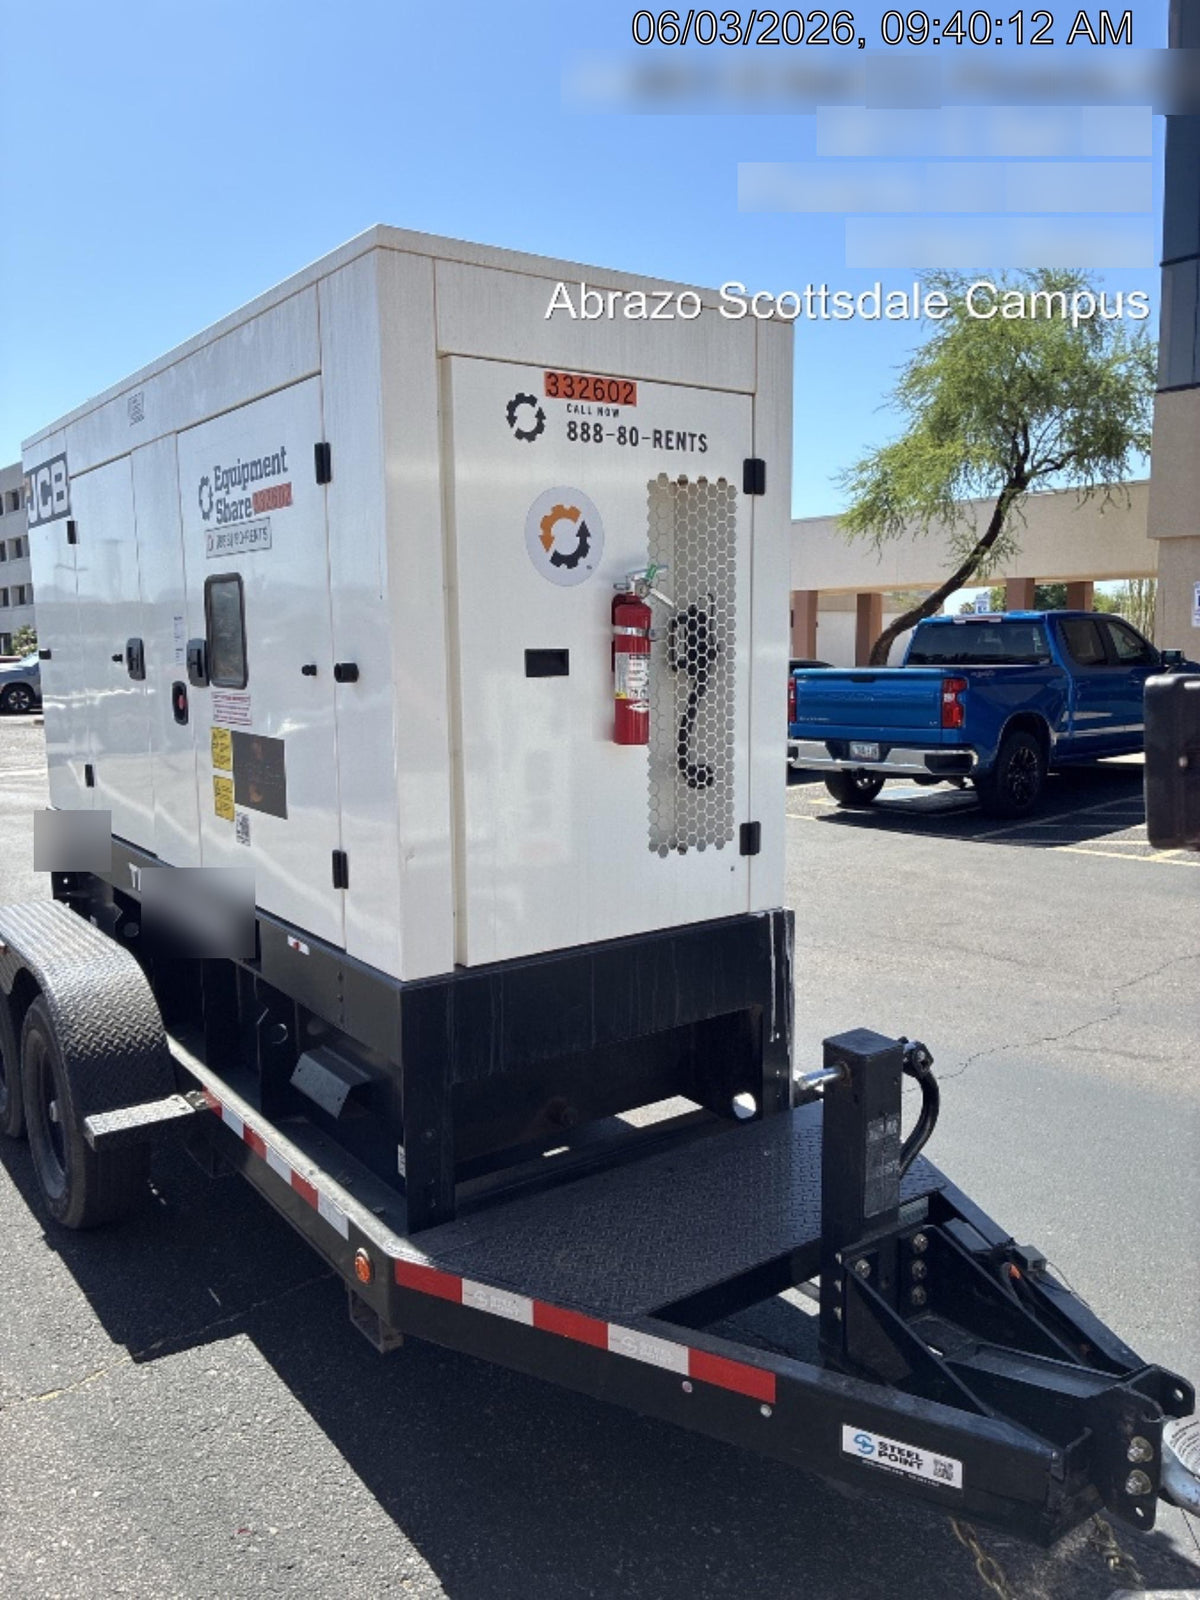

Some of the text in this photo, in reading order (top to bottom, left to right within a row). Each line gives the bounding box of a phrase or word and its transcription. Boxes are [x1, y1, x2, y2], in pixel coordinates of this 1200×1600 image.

[546, 373, 635, 405] 332602
[566, 403, 620, 418] CALL NOW
[567, 420, 708, 453] 888-80-RENTS
[214, 446, 289, 495] Equipment
[26, 456, 70, 526] JCB
[216, 497, 253, 525] Share
[878, 1441, 922, 1461] STEEL
[878, 1450, 923, 1470] POINT
